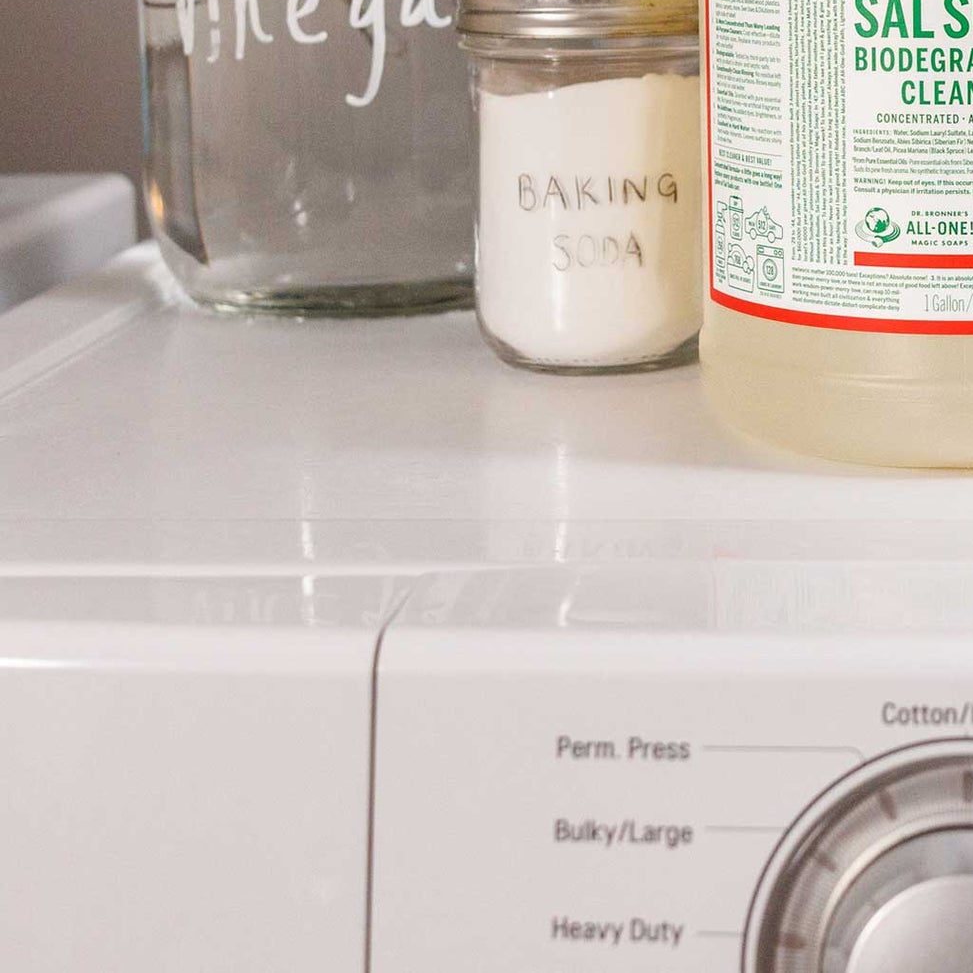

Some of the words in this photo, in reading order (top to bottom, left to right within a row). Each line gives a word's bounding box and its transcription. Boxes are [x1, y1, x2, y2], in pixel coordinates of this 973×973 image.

[877, 113, 960, 124] CONCENTRATED
[518, 173, 678, 211] BAKING
[553, 231, 642, 271] SODA
[925, 295, 929, 311] 1
[556, 735, 620, 759] Perm.
[628, 736, 690, 760] Press
[554, 818, 693, 849] Bulky/Large
[552, 918, 624, 945] Heavy
[630, 918, 683, 945] Duty
